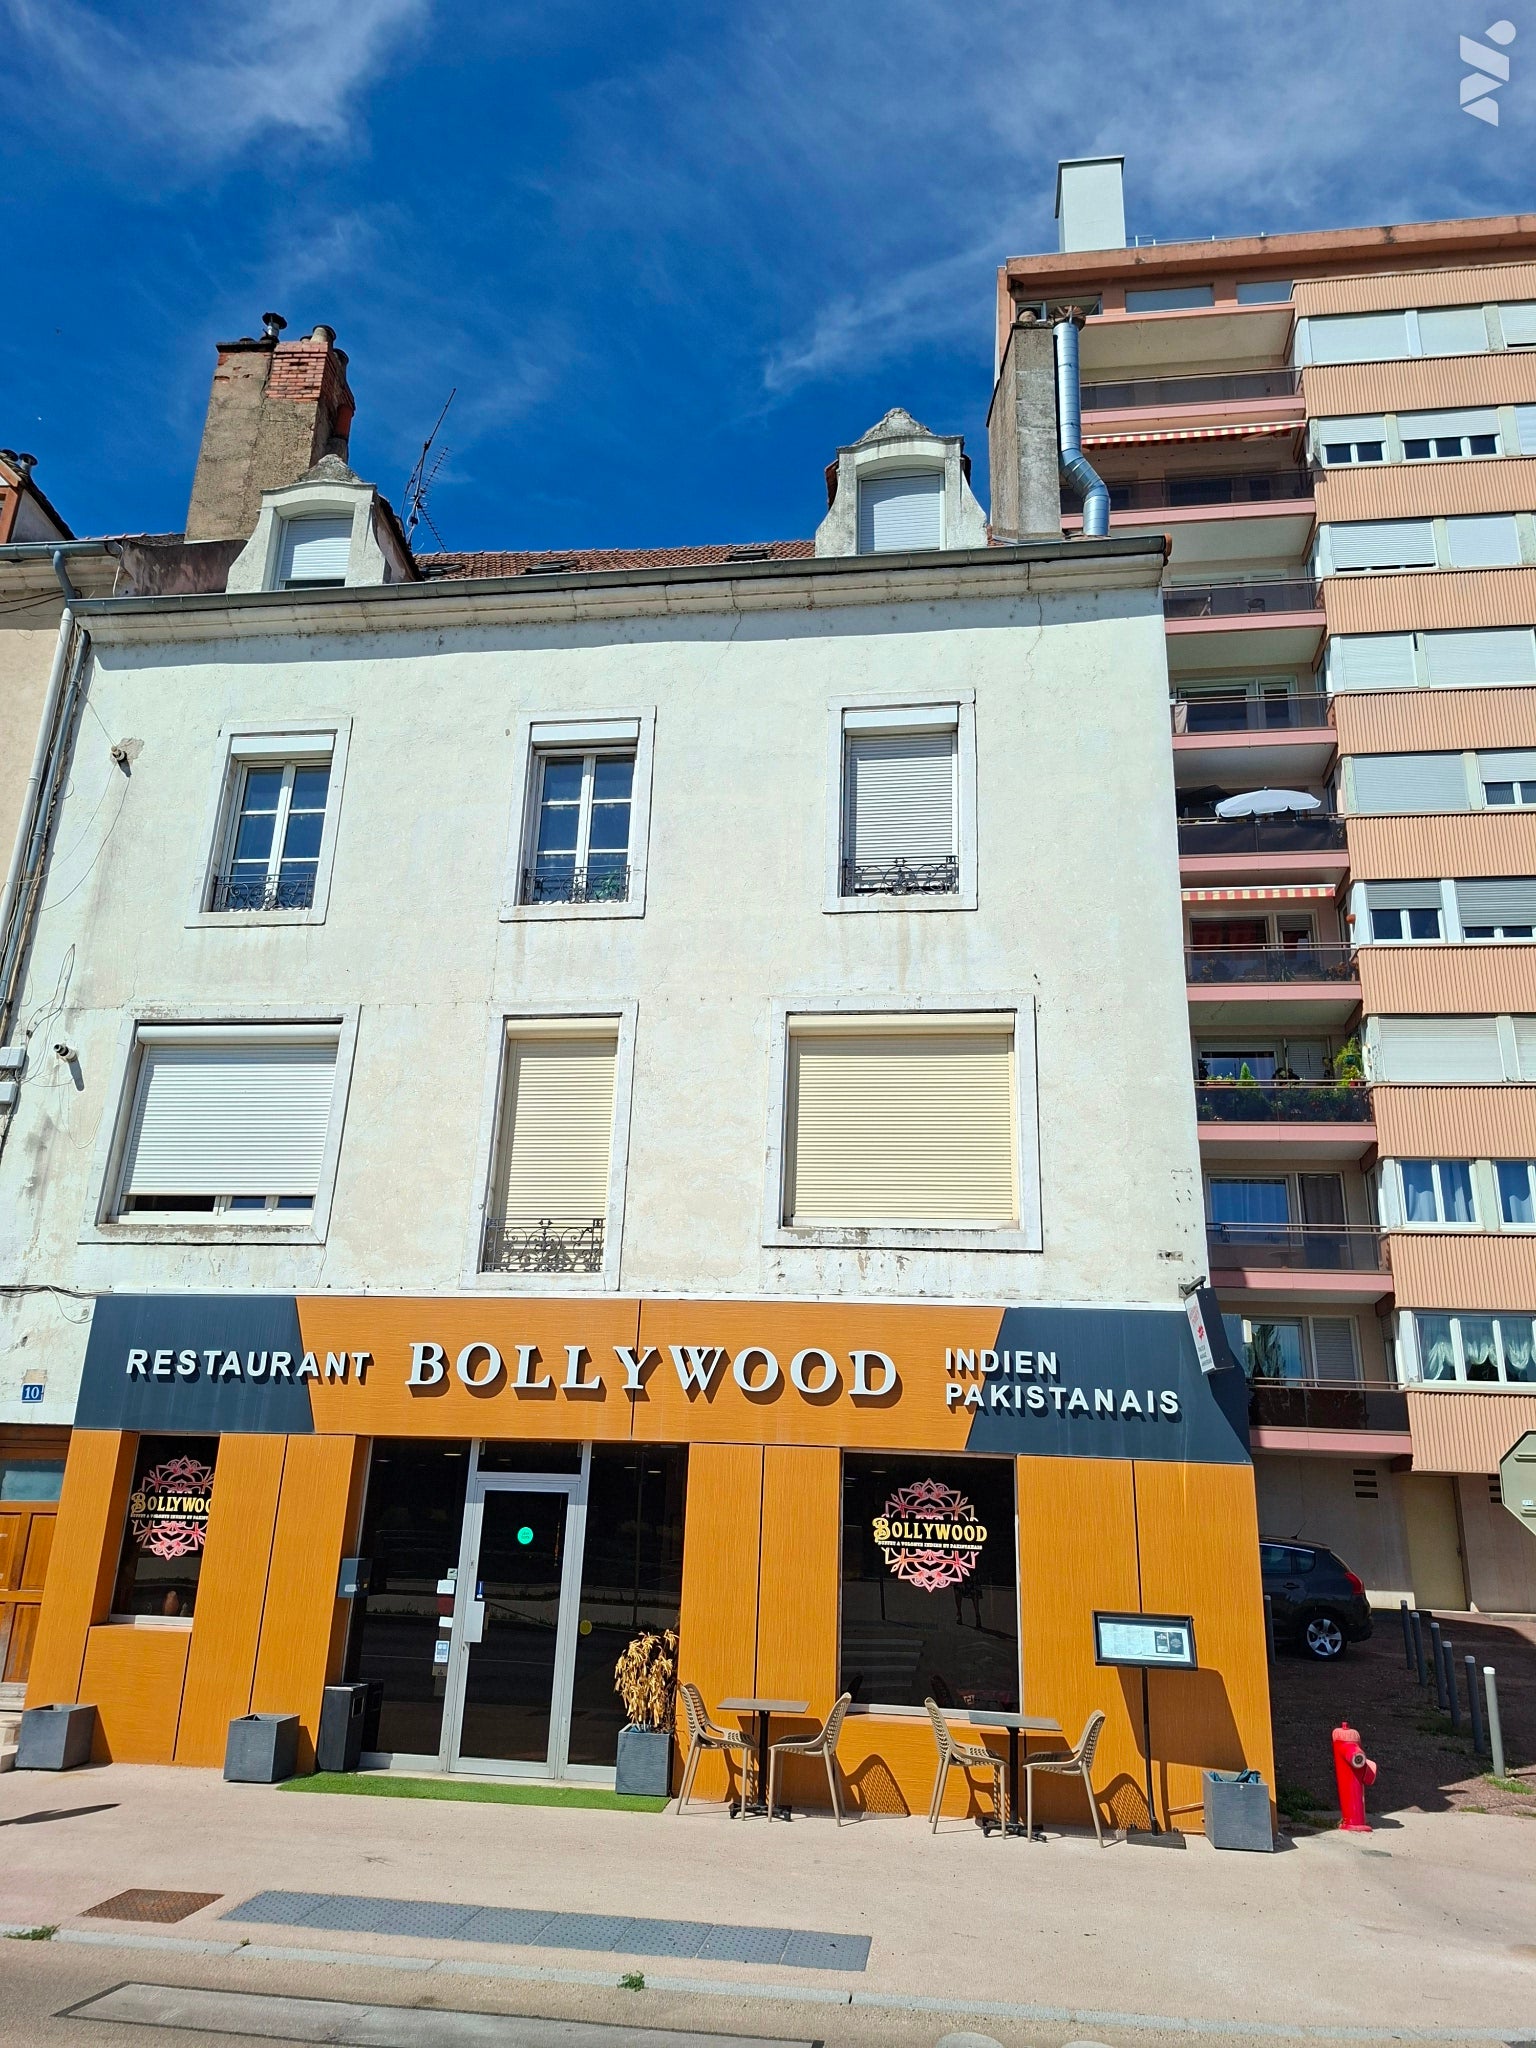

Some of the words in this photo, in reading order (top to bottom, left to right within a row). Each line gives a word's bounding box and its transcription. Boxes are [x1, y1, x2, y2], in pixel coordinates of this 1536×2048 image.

[125, 1349, 370, 1377] RESTAURANT
[405, 1342, 897, 1396] BOLLYWOOD
[945, 1347, 1057, 1375] INDIEN
[24, 1386, 40, 1399] 10
[945, 1383, 1179, 1414] PAKISTANAIS
[872, 1517, 988, 1543] BOLLYWOOD
